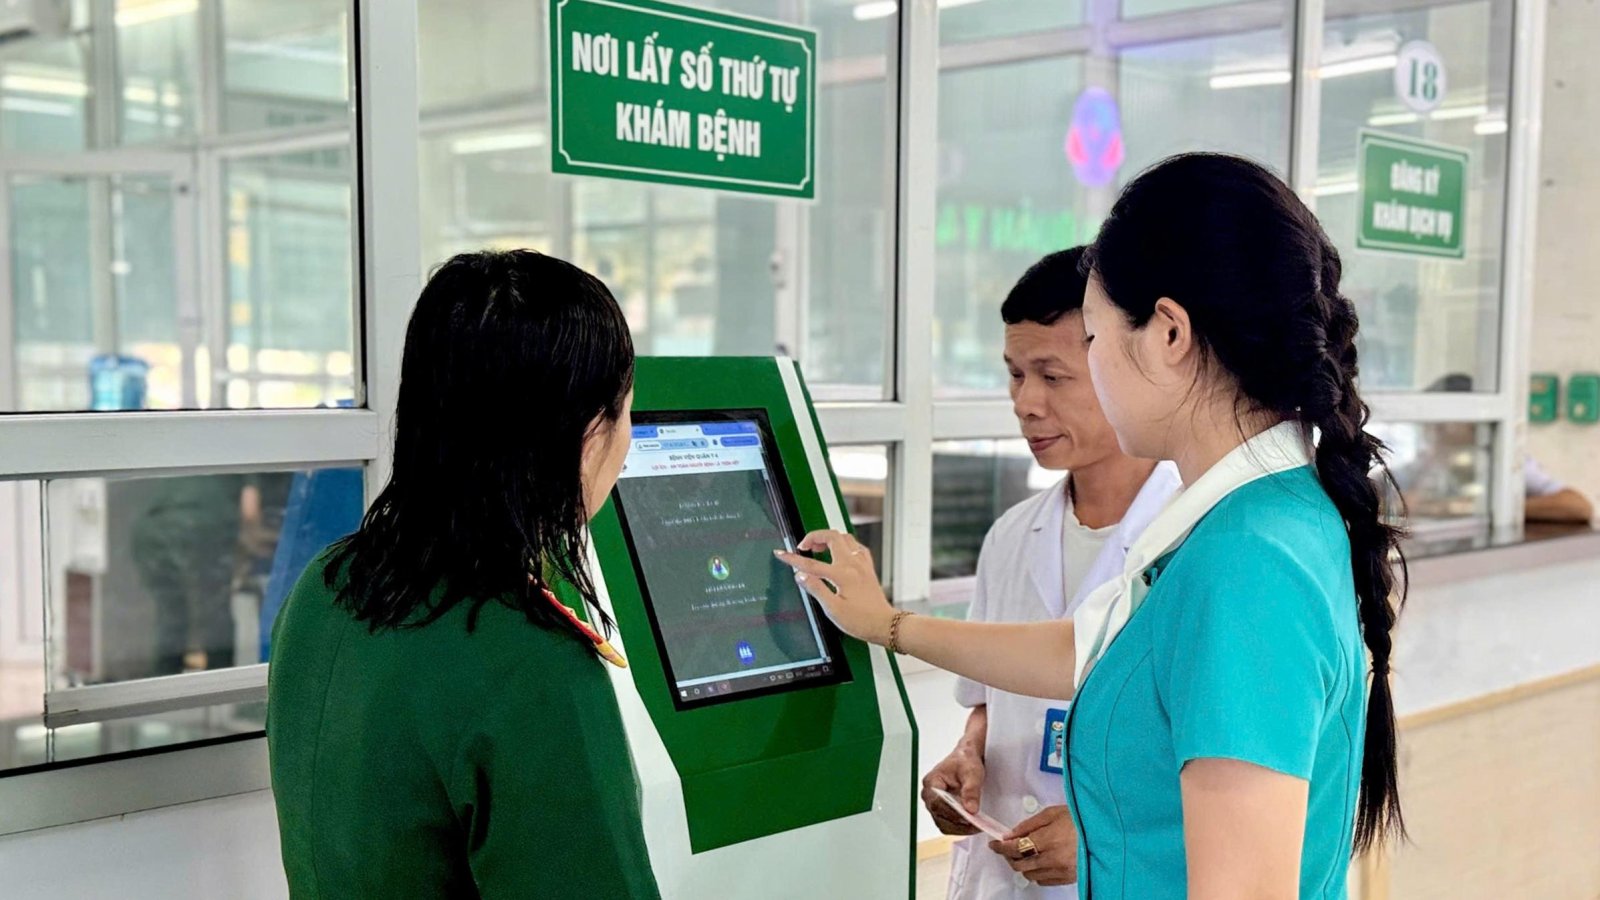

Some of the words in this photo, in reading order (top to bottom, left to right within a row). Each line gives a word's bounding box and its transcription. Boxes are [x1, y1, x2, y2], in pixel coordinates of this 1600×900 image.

[572, 31, 619, 78] NƠI
[626, 31, 674, 85] LẤY
[680, 41, 714, 92] SỐ
[719, 54, 767, 100] THỨ
[769, 65, 800, 113] TỰ
[1410, 58, 1438, 101] 18
[616, 99, 691, 149] KHÁM
[697, 108, 761, 162] BỆNH
